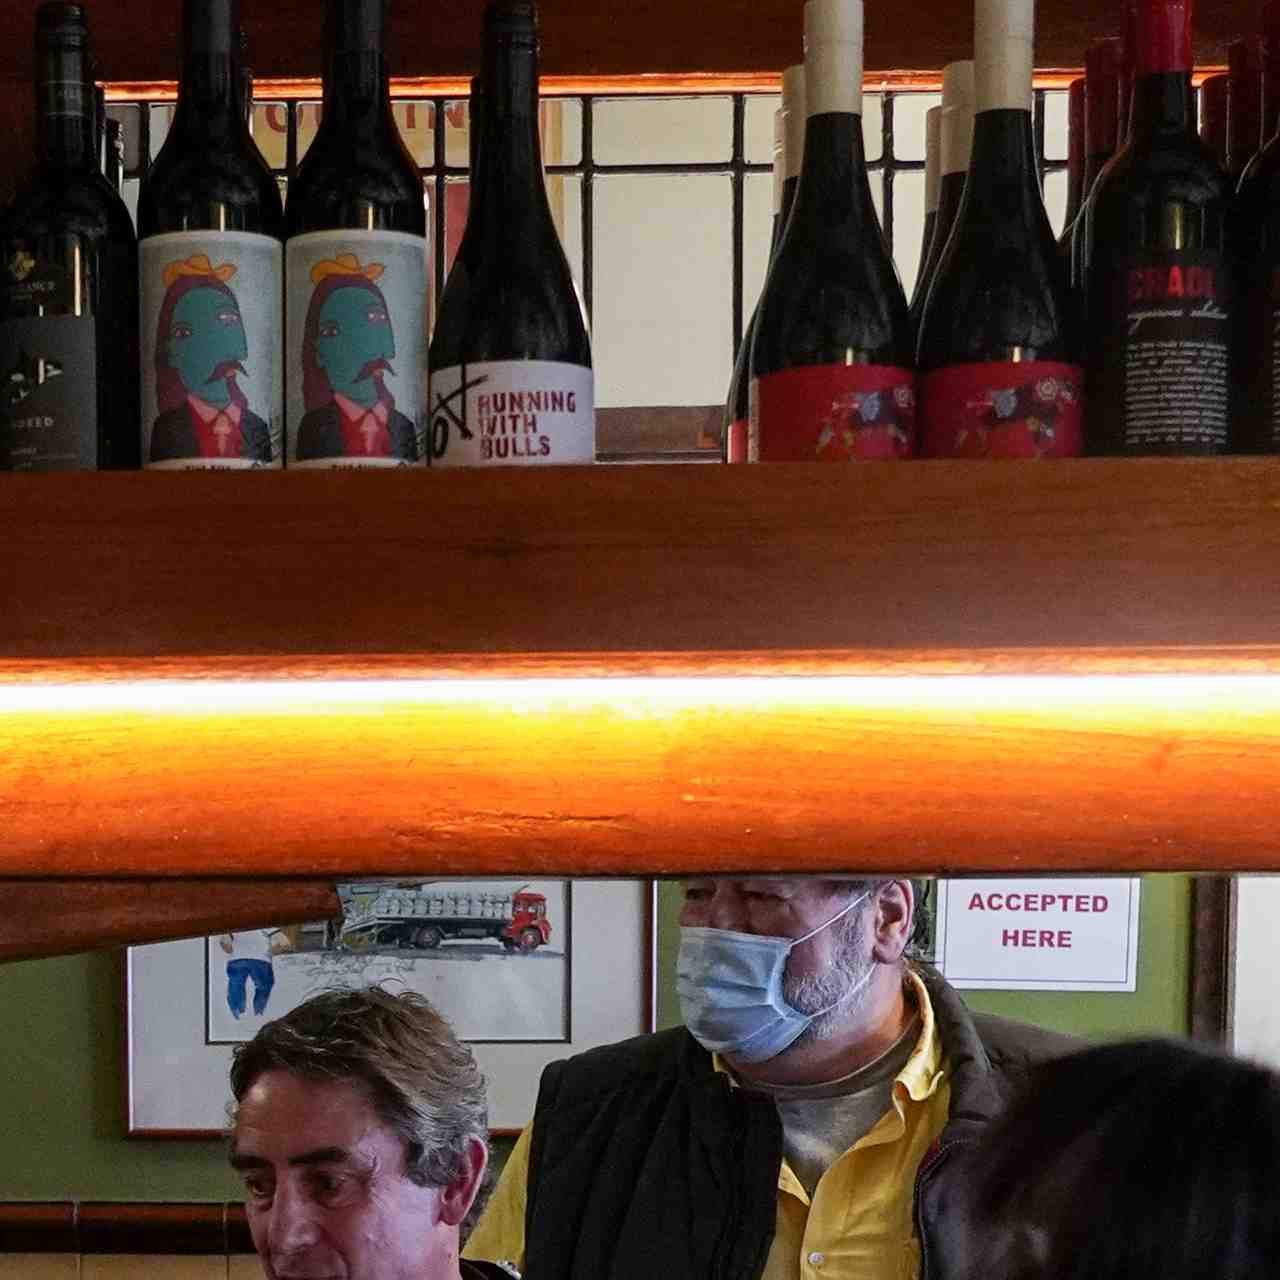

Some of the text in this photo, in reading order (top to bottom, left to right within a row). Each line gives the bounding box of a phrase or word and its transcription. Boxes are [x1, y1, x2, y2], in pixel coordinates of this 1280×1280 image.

[477, 390, 577, 414] RUNNING
[478, 414, 538, 436] WITH
[479, 435, 551, 459] BULLS
[967, 892, 1110, 913] ACCEPTED
[1001, 928, 1073, 949] HERE
